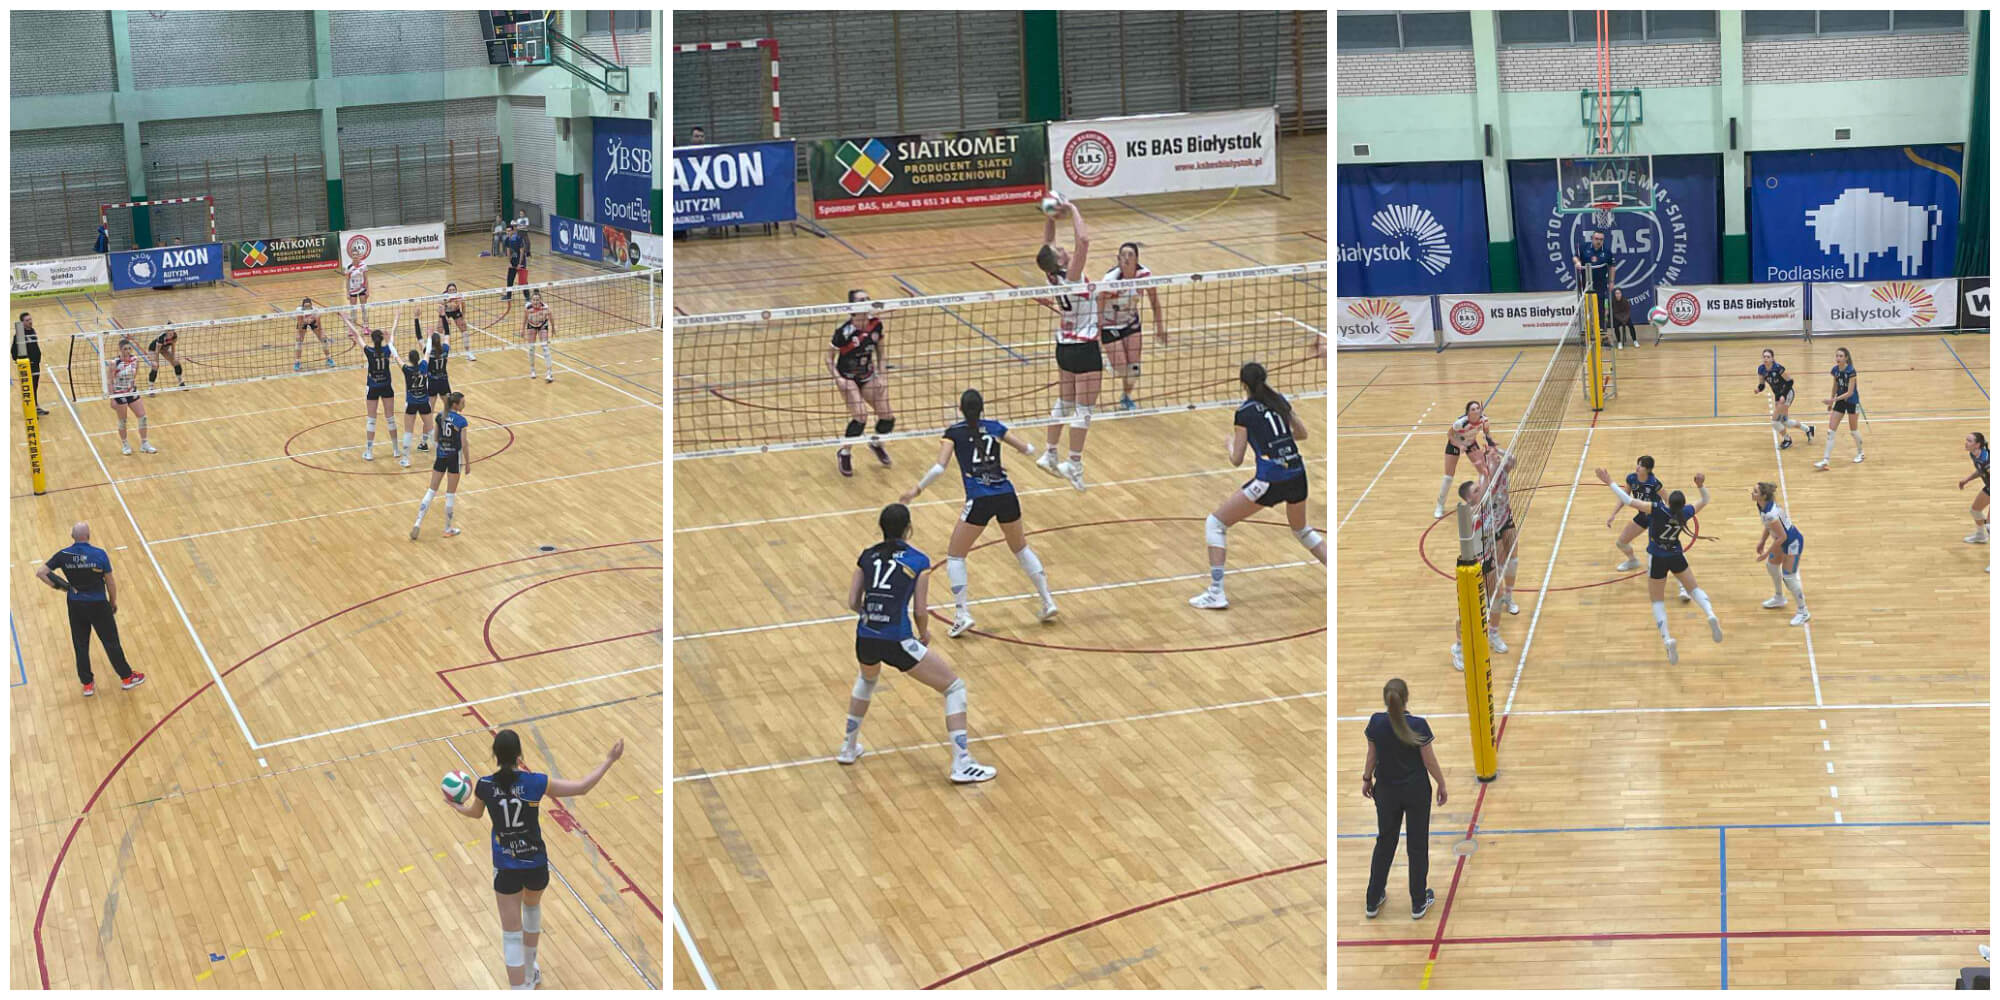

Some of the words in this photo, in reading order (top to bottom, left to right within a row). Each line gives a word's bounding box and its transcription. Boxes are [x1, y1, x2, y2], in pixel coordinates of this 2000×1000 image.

[898, 135, 1019, 161] SIATKOMET
[1127, 140, 1146, 158] KS
[1151, 138, 1182, 156] BAS
[1187, 132, 1262, 154] Białystok
[619, 147, 652, 174] BSB
[904, 160, 972, 174] PRODUCENT
[977, 158, 1012, 169] SIATKI
[912, 169, 1006, 184] OGRODZENIOWEJ
[673, 197, 721, 214] UTYZM
[818, 204, 856, 215] Sponsor
[858, 202, 880, 211] BAS,
[573, 223, 596, 244] AXON
[270, 237, 327, 251] SIATKOMET
[376, 239, 386, 247] KS
[387, 237, 402, 246] BAS
[162, 247, 208, 268] AXON
[1767, 265, 1845, 281] Podlaskie
[1706, 299, 1720, 310] KS
[1723, 299, 1743, 310] BAS
[1746, 297, 1795, 311] Białystok
[1490, 308, 1504, 319] KS
[1507, 307, 1527, 318] BAS
[1830, 305, 1901, 322] Białystok
[375, 358, 386, 370] 11
[435, 359, 444, 370] 17
[411, 375, 424, 388] 22
[442, 421, 452, 437] 16
[1659, 524, 1680, 540] 22
[872, 558, 897, 590] 12
[499, 798, 524, 828] 12
